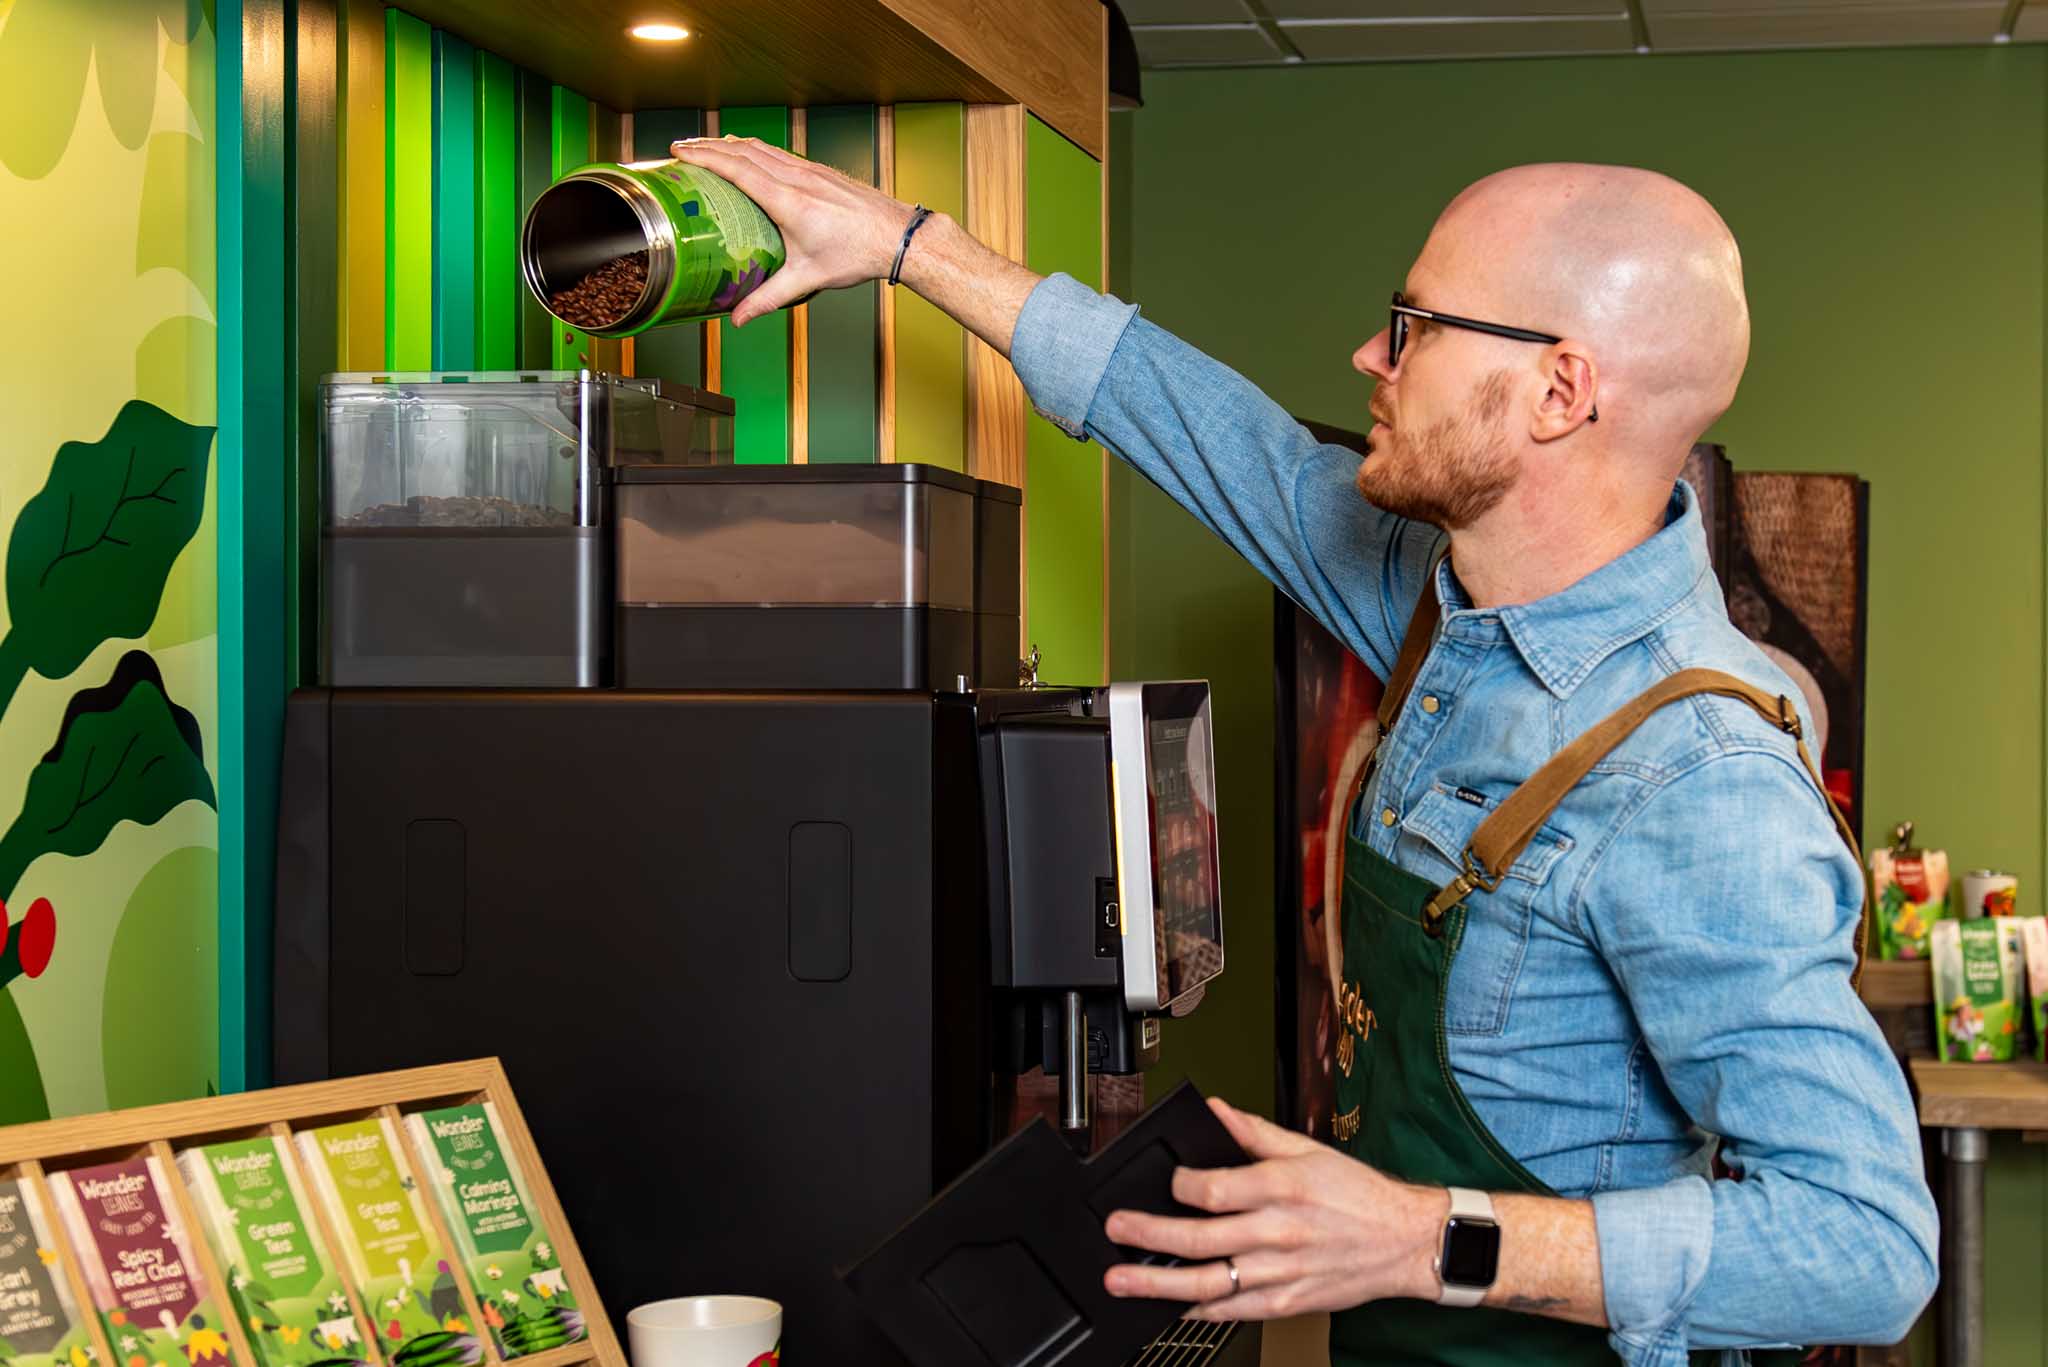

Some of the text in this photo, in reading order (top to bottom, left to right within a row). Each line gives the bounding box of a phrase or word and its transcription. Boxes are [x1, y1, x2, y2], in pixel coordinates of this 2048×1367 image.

[430, 1115, 485, 1138] Wonder
[322, 1132, 380, 1157] Wonder
[212, 1150, 273, 1175] Wonder
[78, 1173, 146, 1200] Wonder
[459, 1179, 512, 1199] Calming
[357, 1200, 402, 1219] Green
[463, 1194, 520, 1216] Moringa
[248, 1221, 295, 1240] Green
[372, 1218, 401, 1232] Tea
[263, 1239, 293, 1255] Tea
[117, 1248, 164, 1270] Spicy
[111, 1260, 184, 1289] Red Chai
